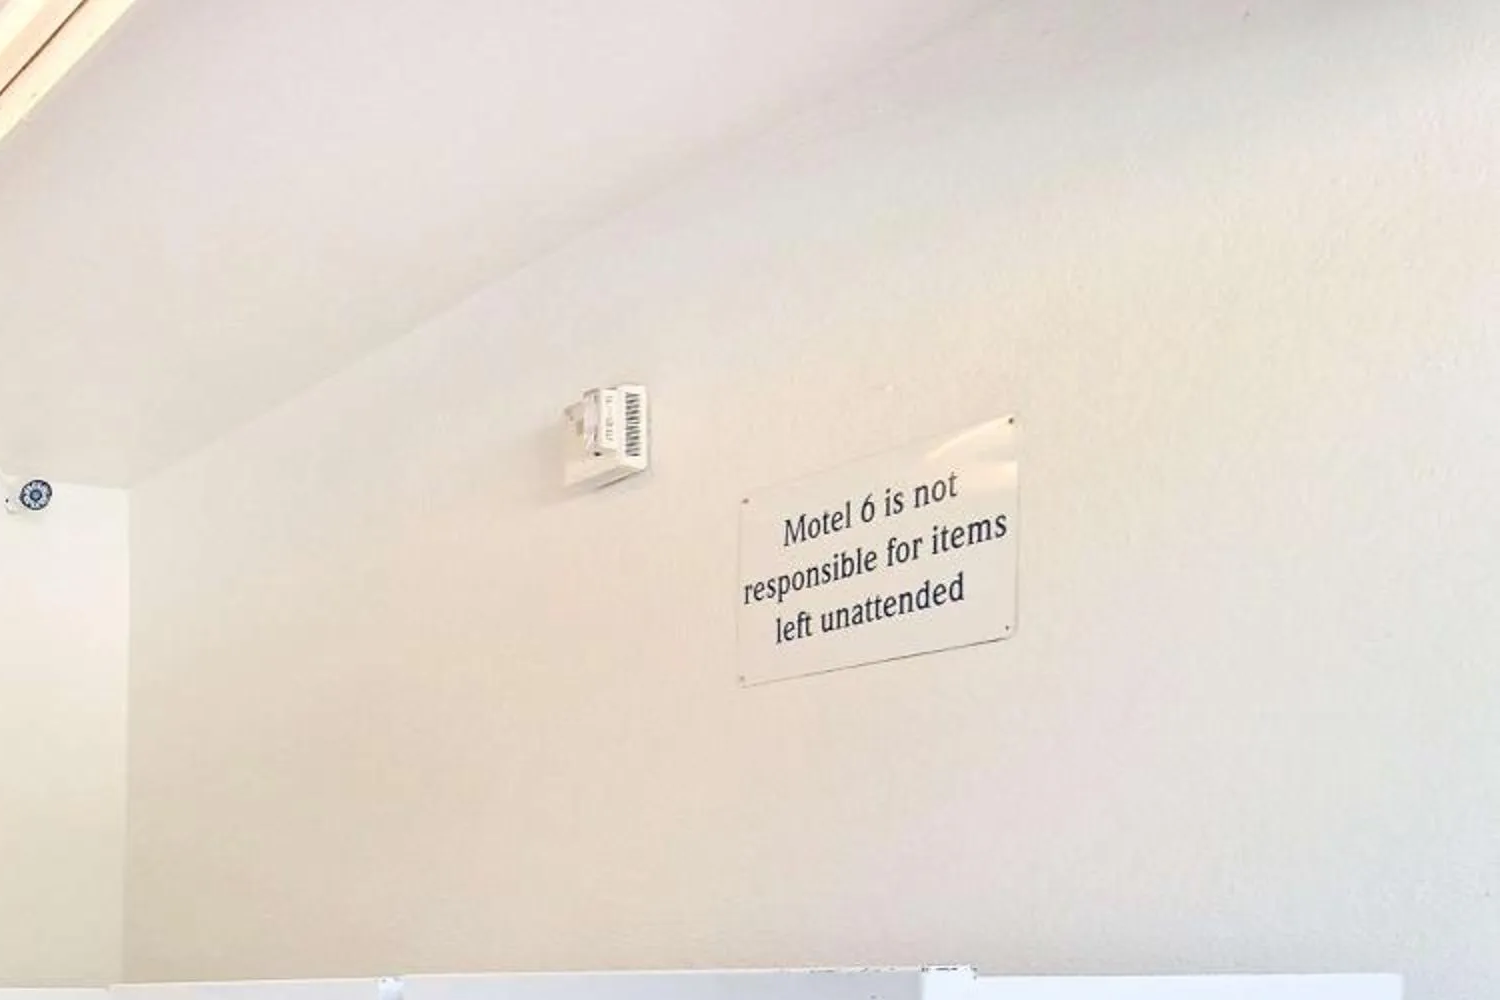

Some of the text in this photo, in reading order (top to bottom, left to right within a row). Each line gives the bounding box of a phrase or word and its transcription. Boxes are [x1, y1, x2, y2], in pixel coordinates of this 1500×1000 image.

[782, 471, 958, 547] Motel 6 is not
[743, 512, 1008, 605] responsible for items
[775, 571, 965, 645] left unattended
